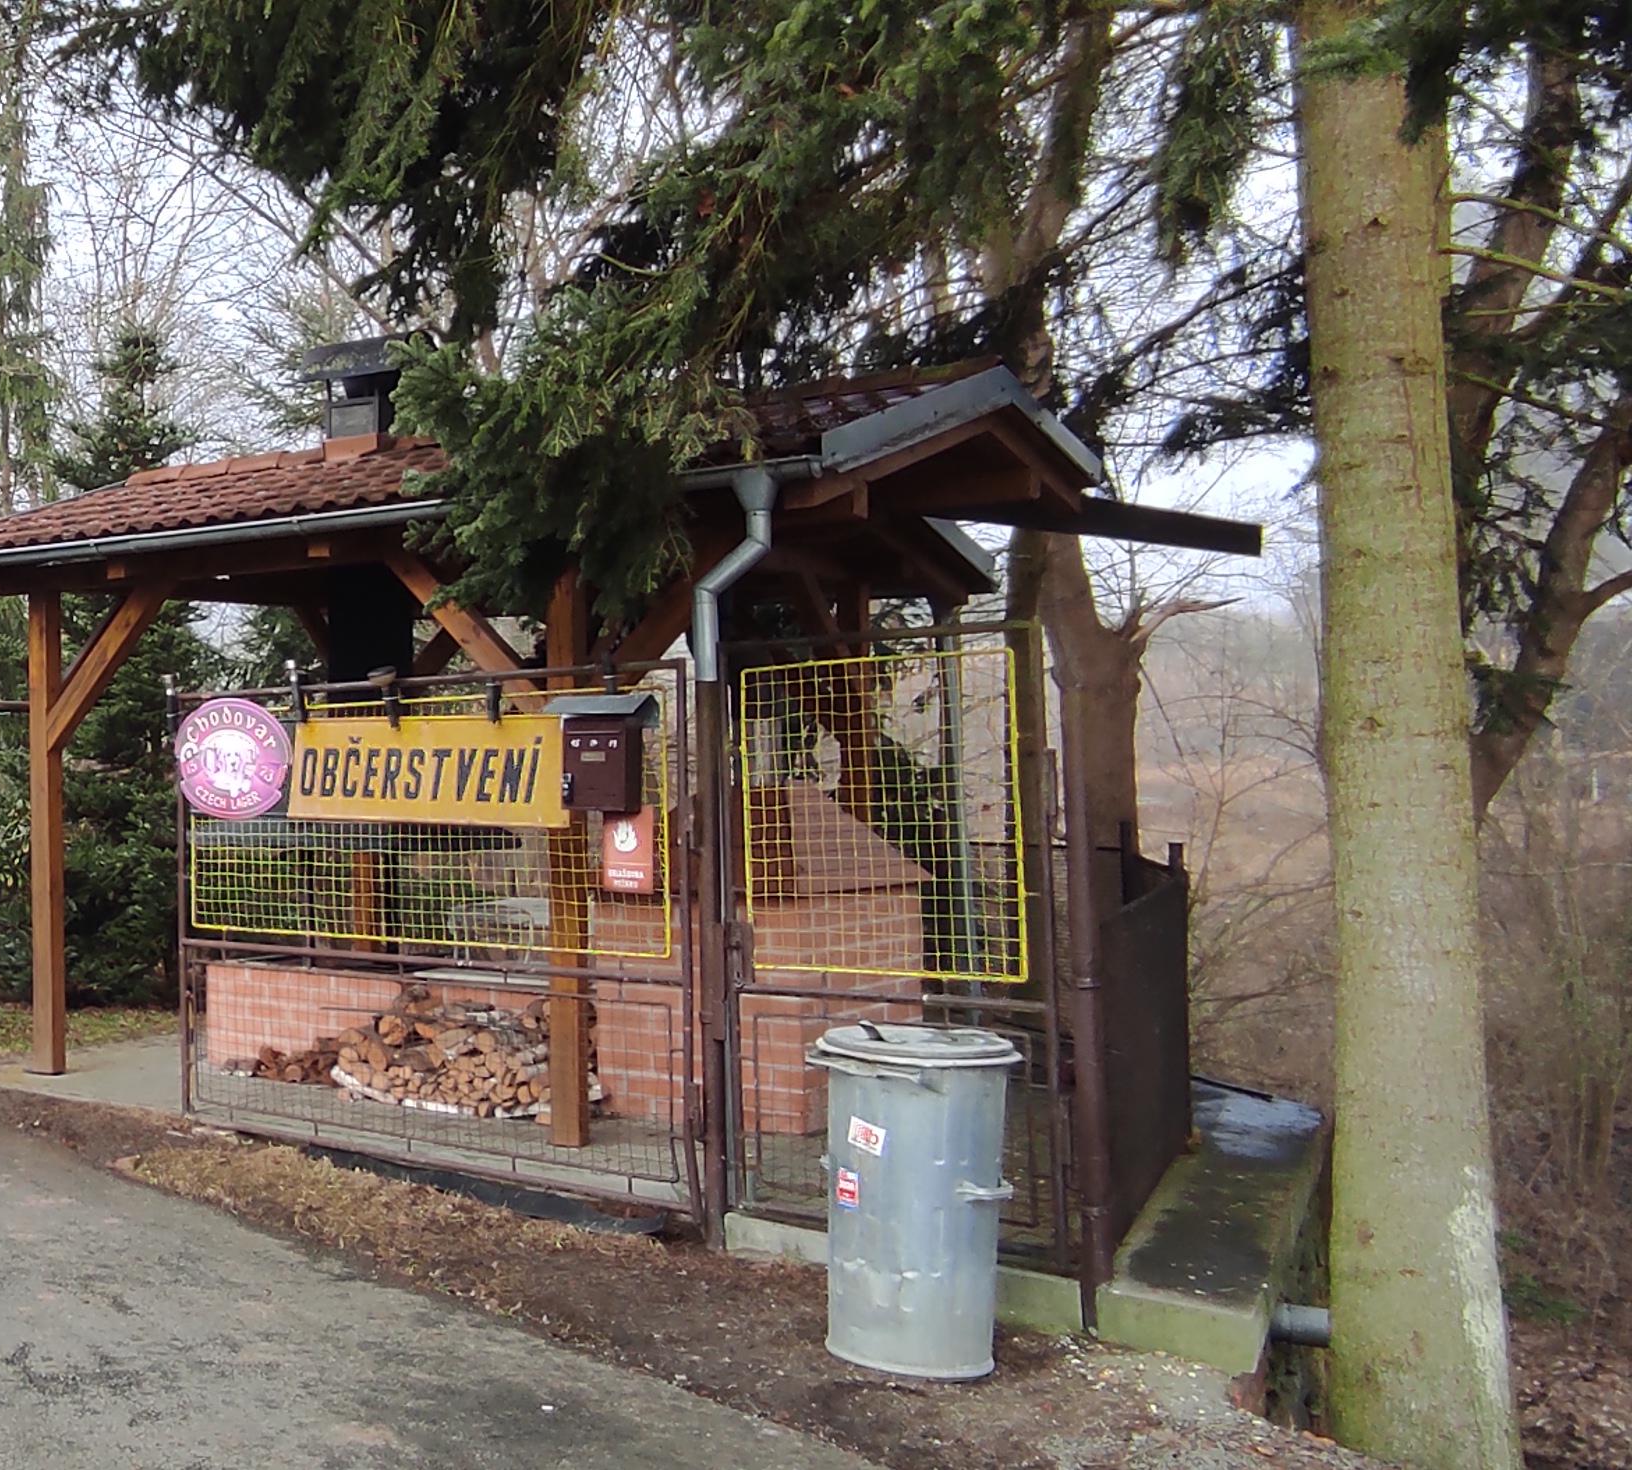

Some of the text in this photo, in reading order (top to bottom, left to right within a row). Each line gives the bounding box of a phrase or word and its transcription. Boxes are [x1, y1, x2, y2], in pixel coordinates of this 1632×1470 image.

[187, 706, 276, 748] Chodovar
[301, 735, 543, 804] OBČERSTVENÍ
[195, 786, 262, 810] CZECH LAGER
